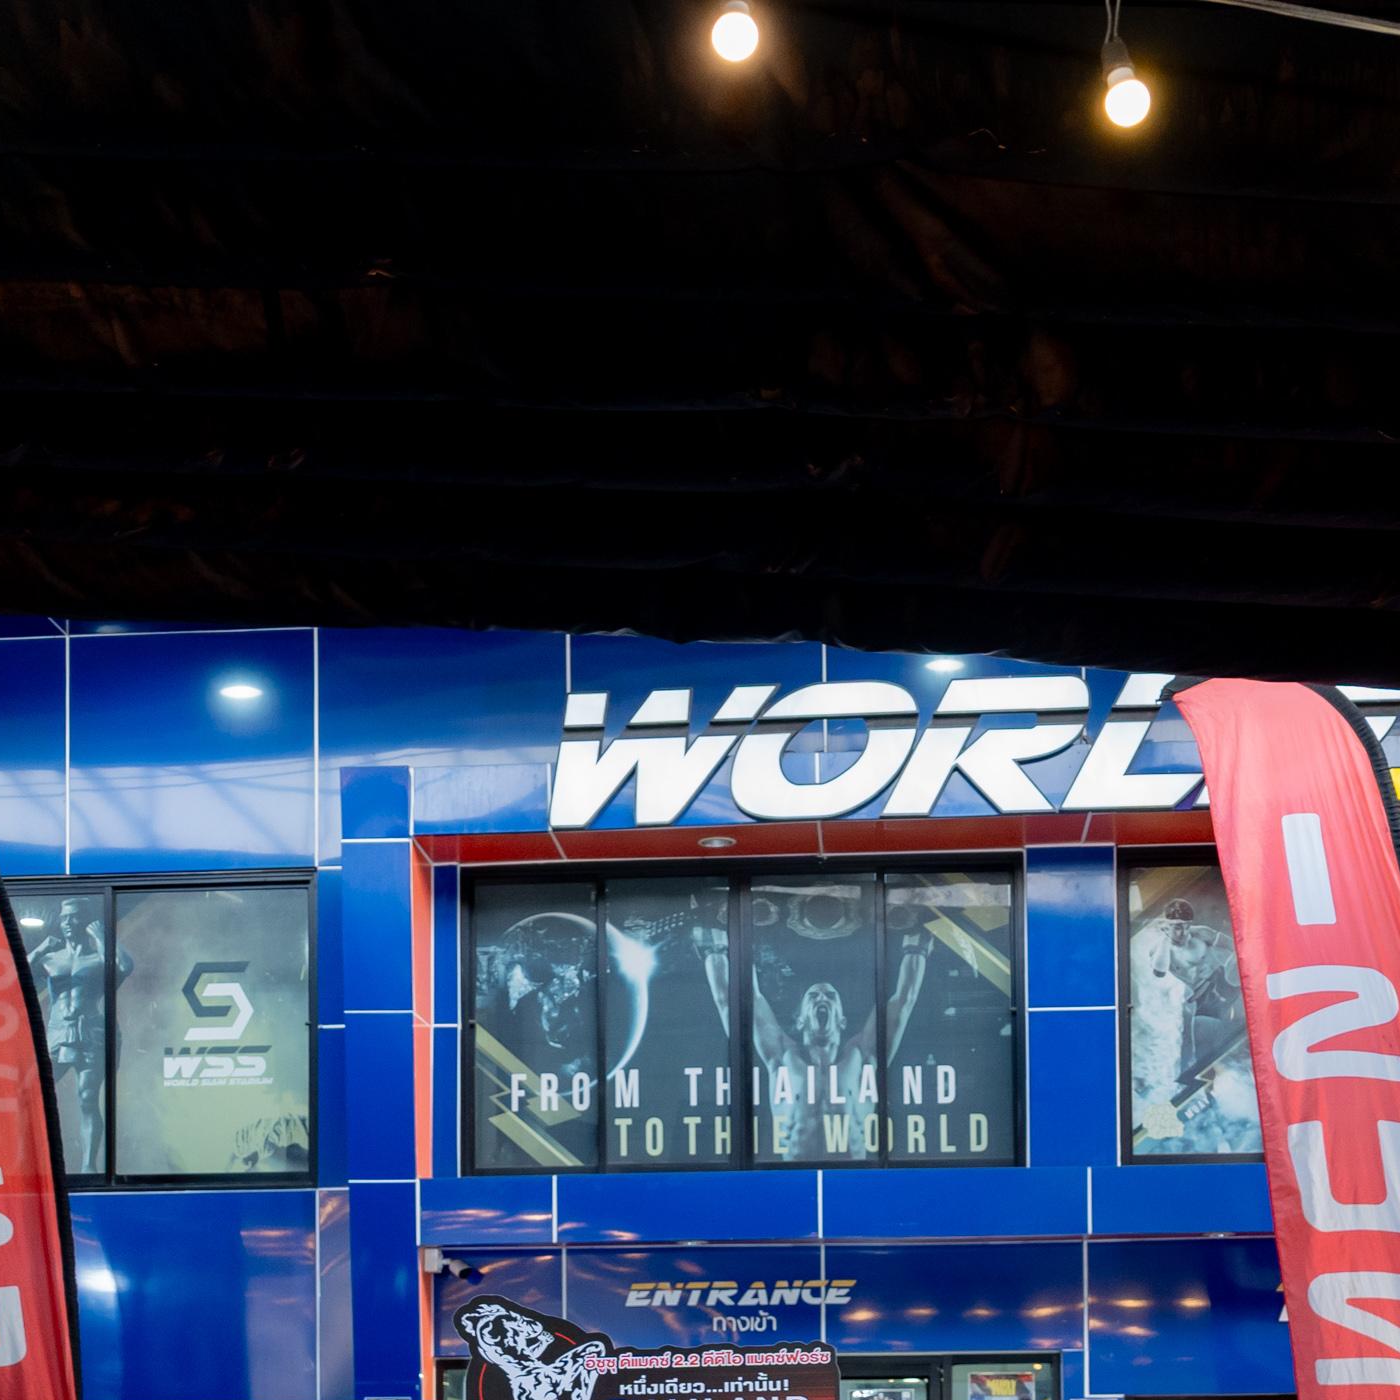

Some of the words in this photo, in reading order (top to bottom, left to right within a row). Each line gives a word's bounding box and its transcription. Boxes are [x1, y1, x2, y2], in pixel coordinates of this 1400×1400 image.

[511, 1069, 639, 1112] FROM
[684, 1065, 957, 1107] THAILAND
[614, 1117, 663, 1157] TO
[683, 1114, 790, 1155] THE
[824, 1113, 989, 1153] WORLD
[625, 1279, 856, 1307] ENTRANCE
[712, 1311, 777, 1332] ทางเข้า
[585, 1353, 617, 1374] อีซูซุ
[619, 1352, 670, 1369] ดีแมคซ์
[674, 1353, 699, 1368] 2.2
[702, 1350, 742, 1366] ดีดีไอ
